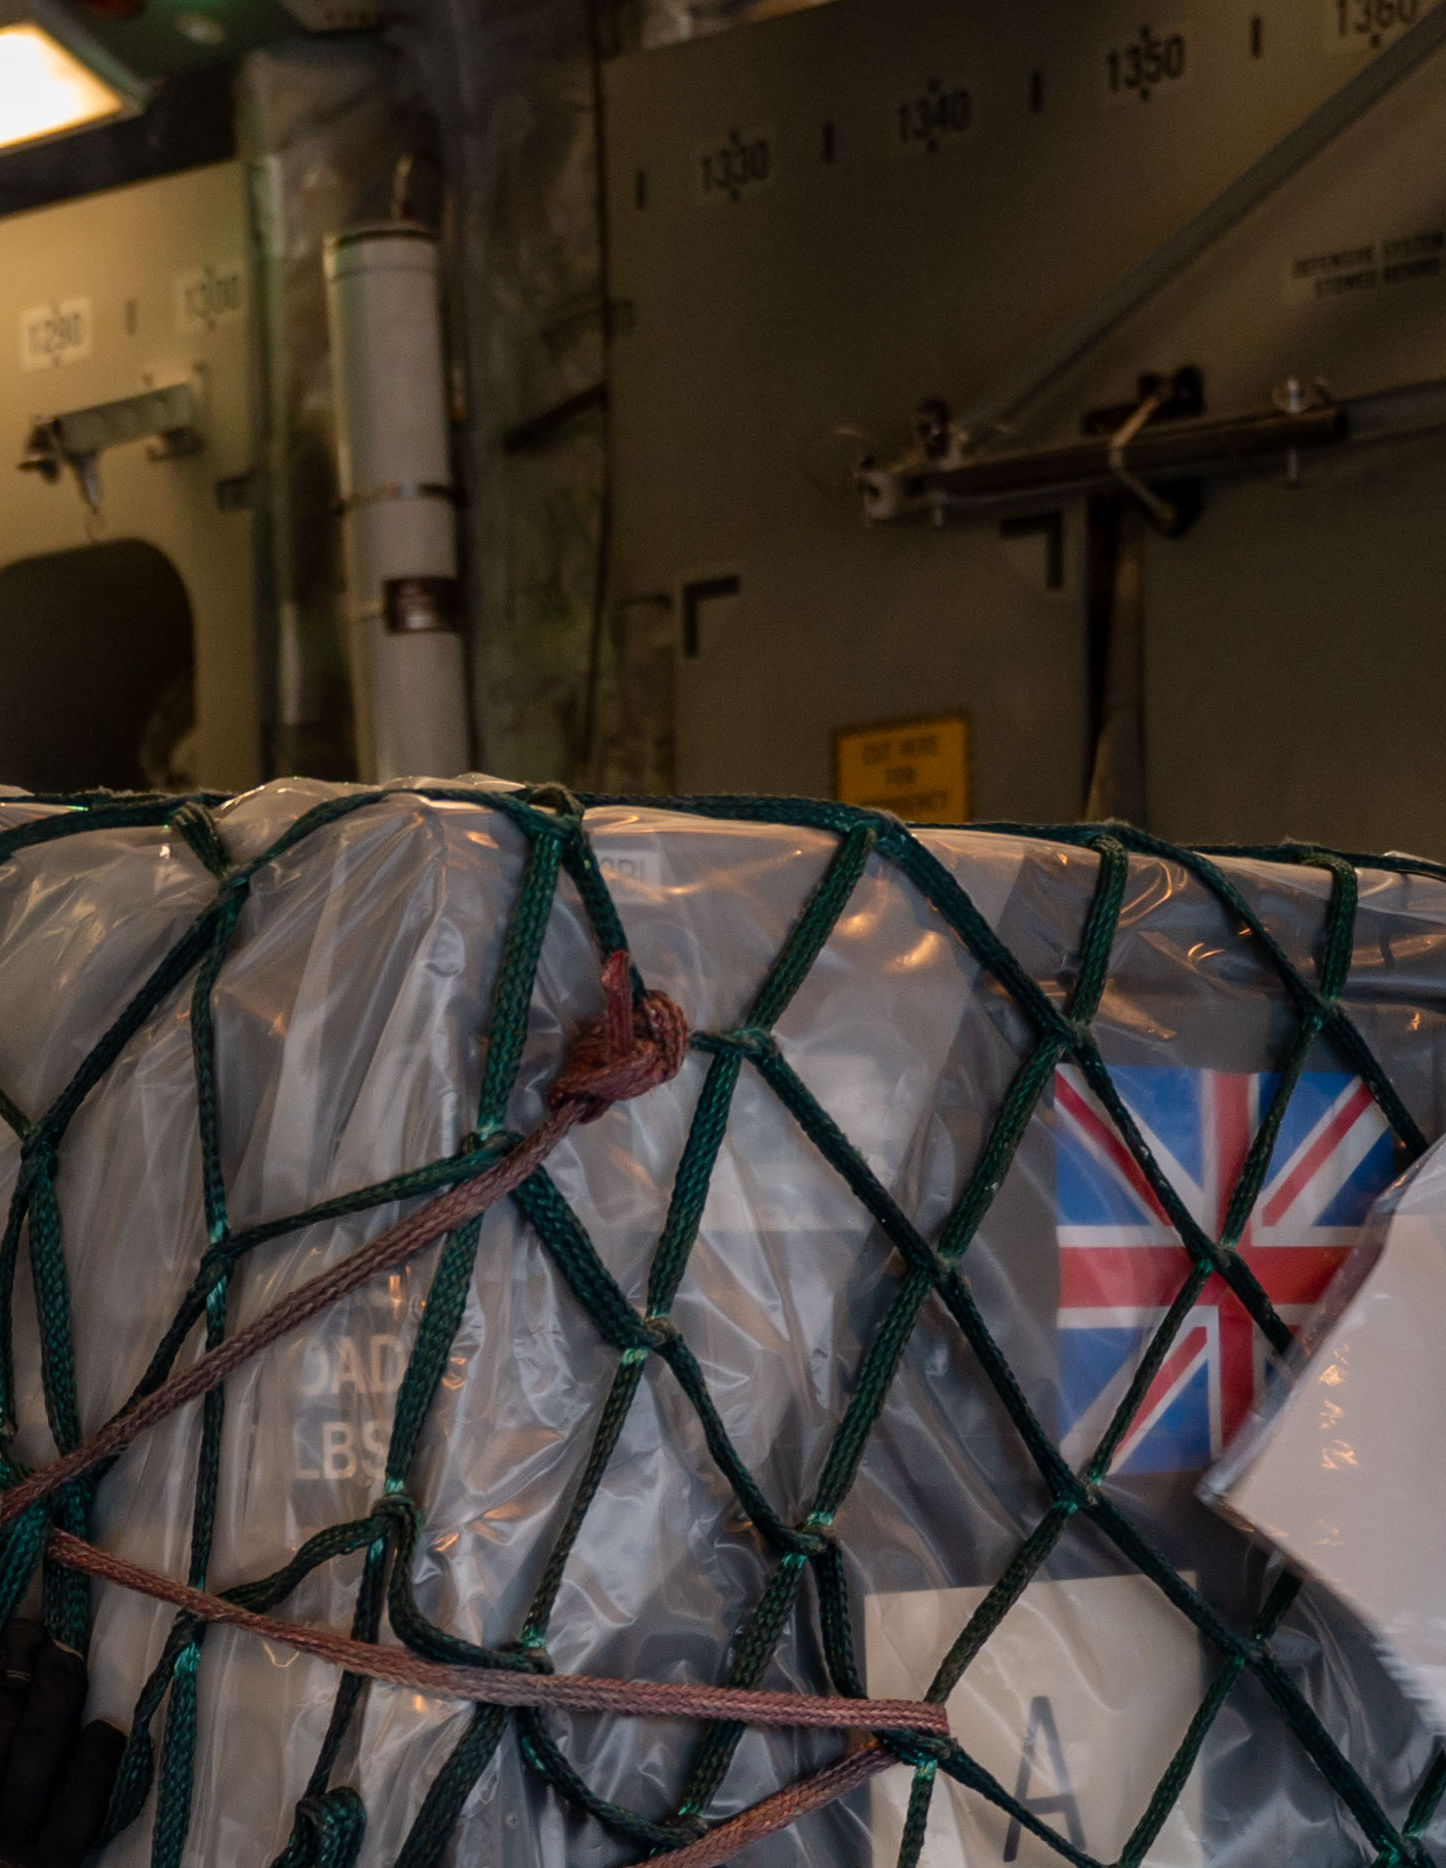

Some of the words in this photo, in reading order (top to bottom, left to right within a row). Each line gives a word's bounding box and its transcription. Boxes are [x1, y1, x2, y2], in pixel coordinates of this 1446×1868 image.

[1107, 34, 1184, 92] 1350
[900, 90, 971, 142] 1340
[702, 140, 769, 192] 1330
[1381, 231, 1444, 262] SYSTEM
[1003, 1696, 1086, 1862] A
